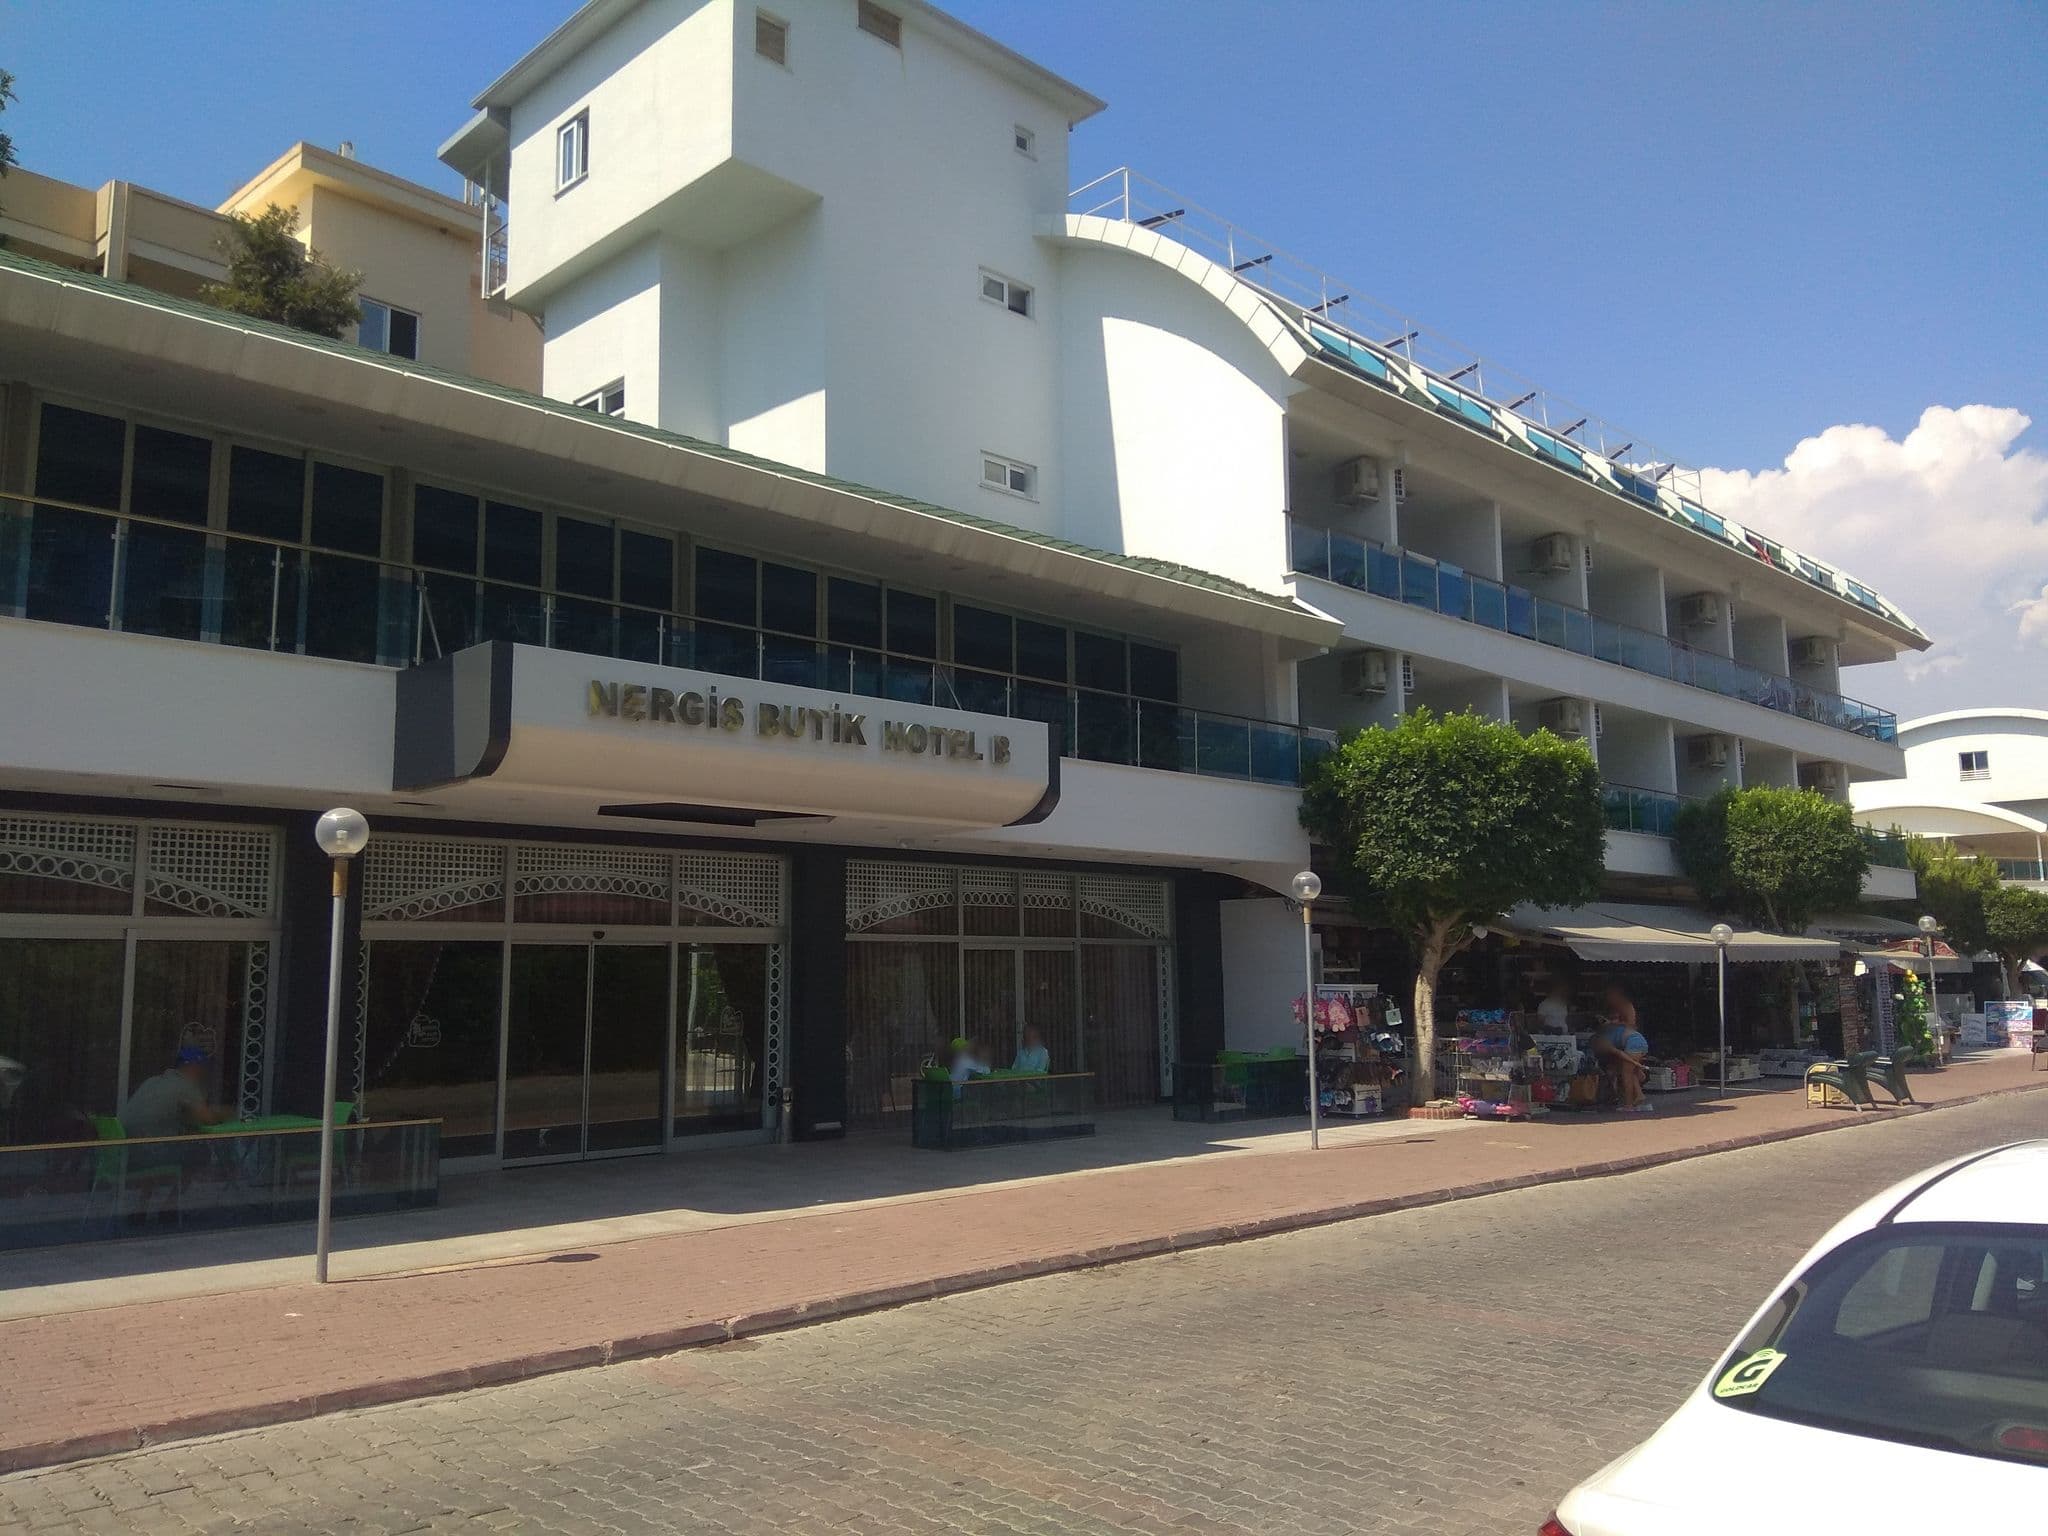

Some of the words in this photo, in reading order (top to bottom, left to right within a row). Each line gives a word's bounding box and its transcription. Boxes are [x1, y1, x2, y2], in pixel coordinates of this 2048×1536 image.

[588, 679, 744, 730] NERGİS
[757, 702, 867, 746] BUTİK
[882, 720, 984, 761] HOTEL
[991, 735, 1011, 764] B
[1733, 1358, 1773, 1383] G
